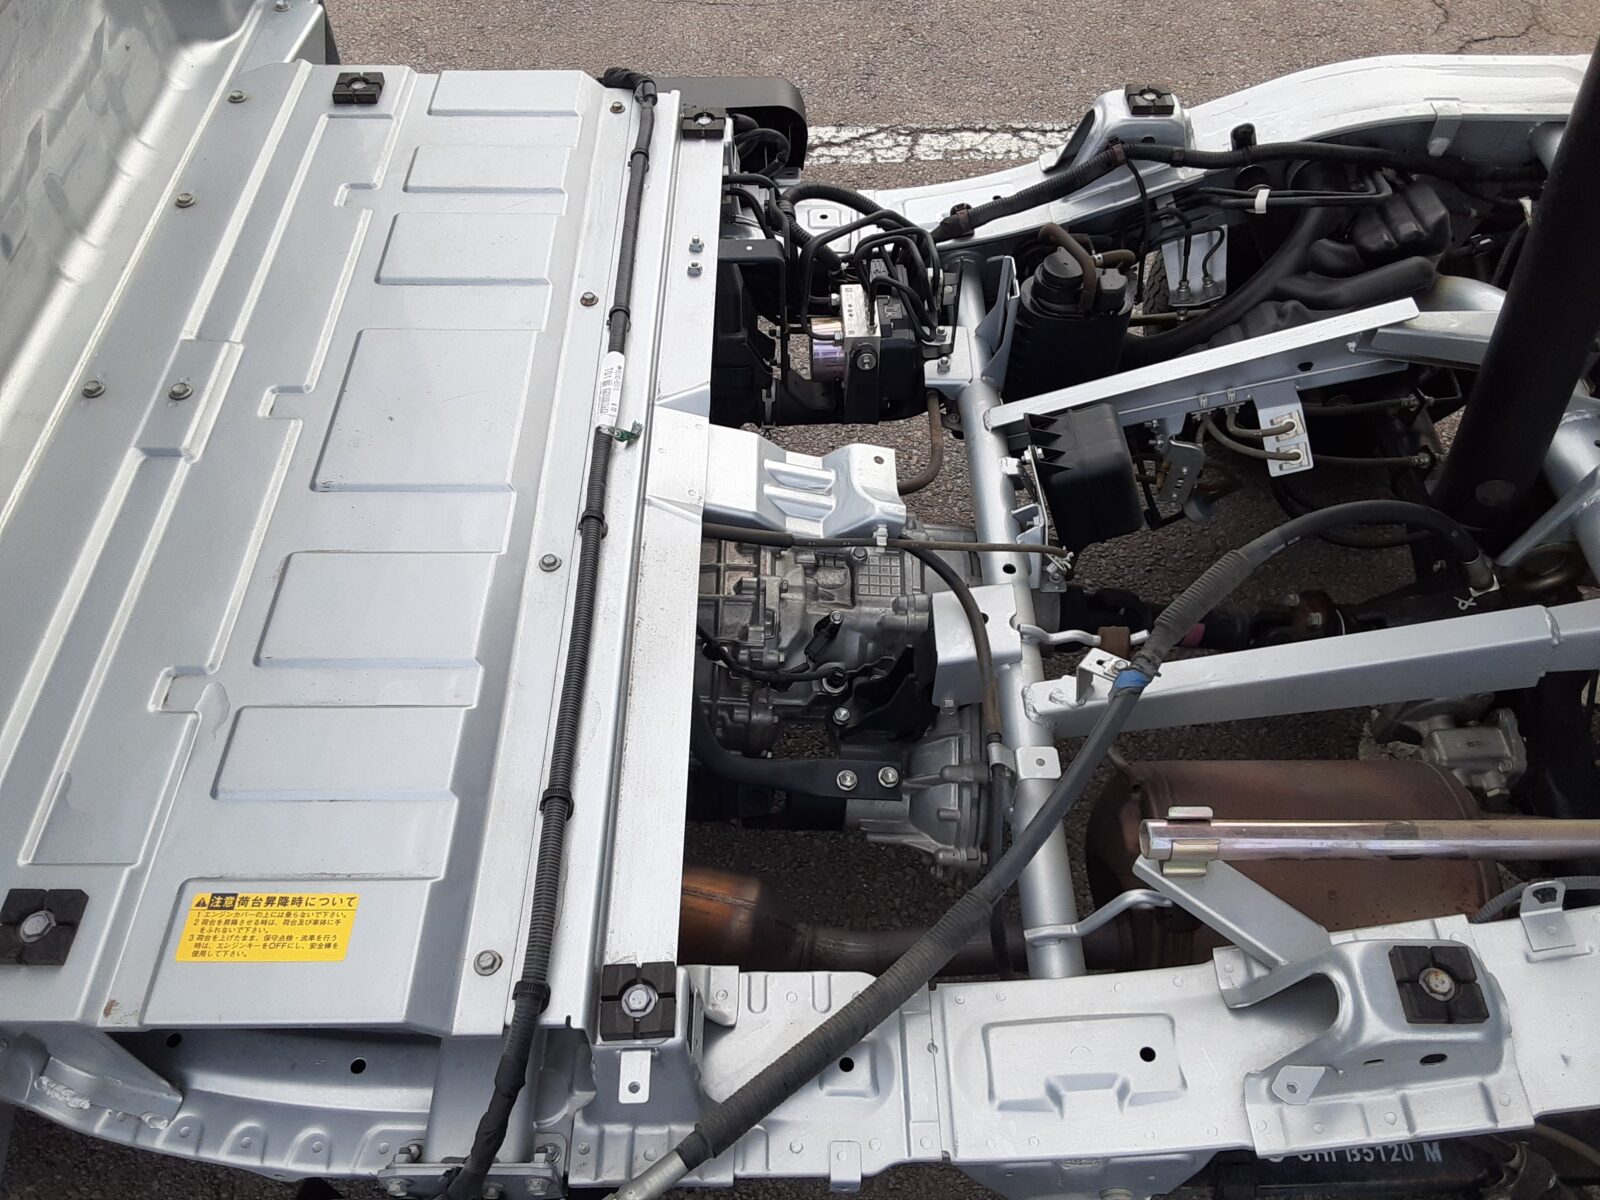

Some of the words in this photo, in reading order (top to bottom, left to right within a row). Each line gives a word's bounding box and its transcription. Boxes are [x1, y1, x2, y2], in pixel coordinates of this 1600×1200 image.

[209, 895, 236, 908] 注意
[237, 895, 357, 908] 荷台昇降時について
[199, 926, 269, 934] をふれないで下さい。
[191, 950, 247, 958] 使用して下さい。
[1422, 1141, 1443, 1163] M
